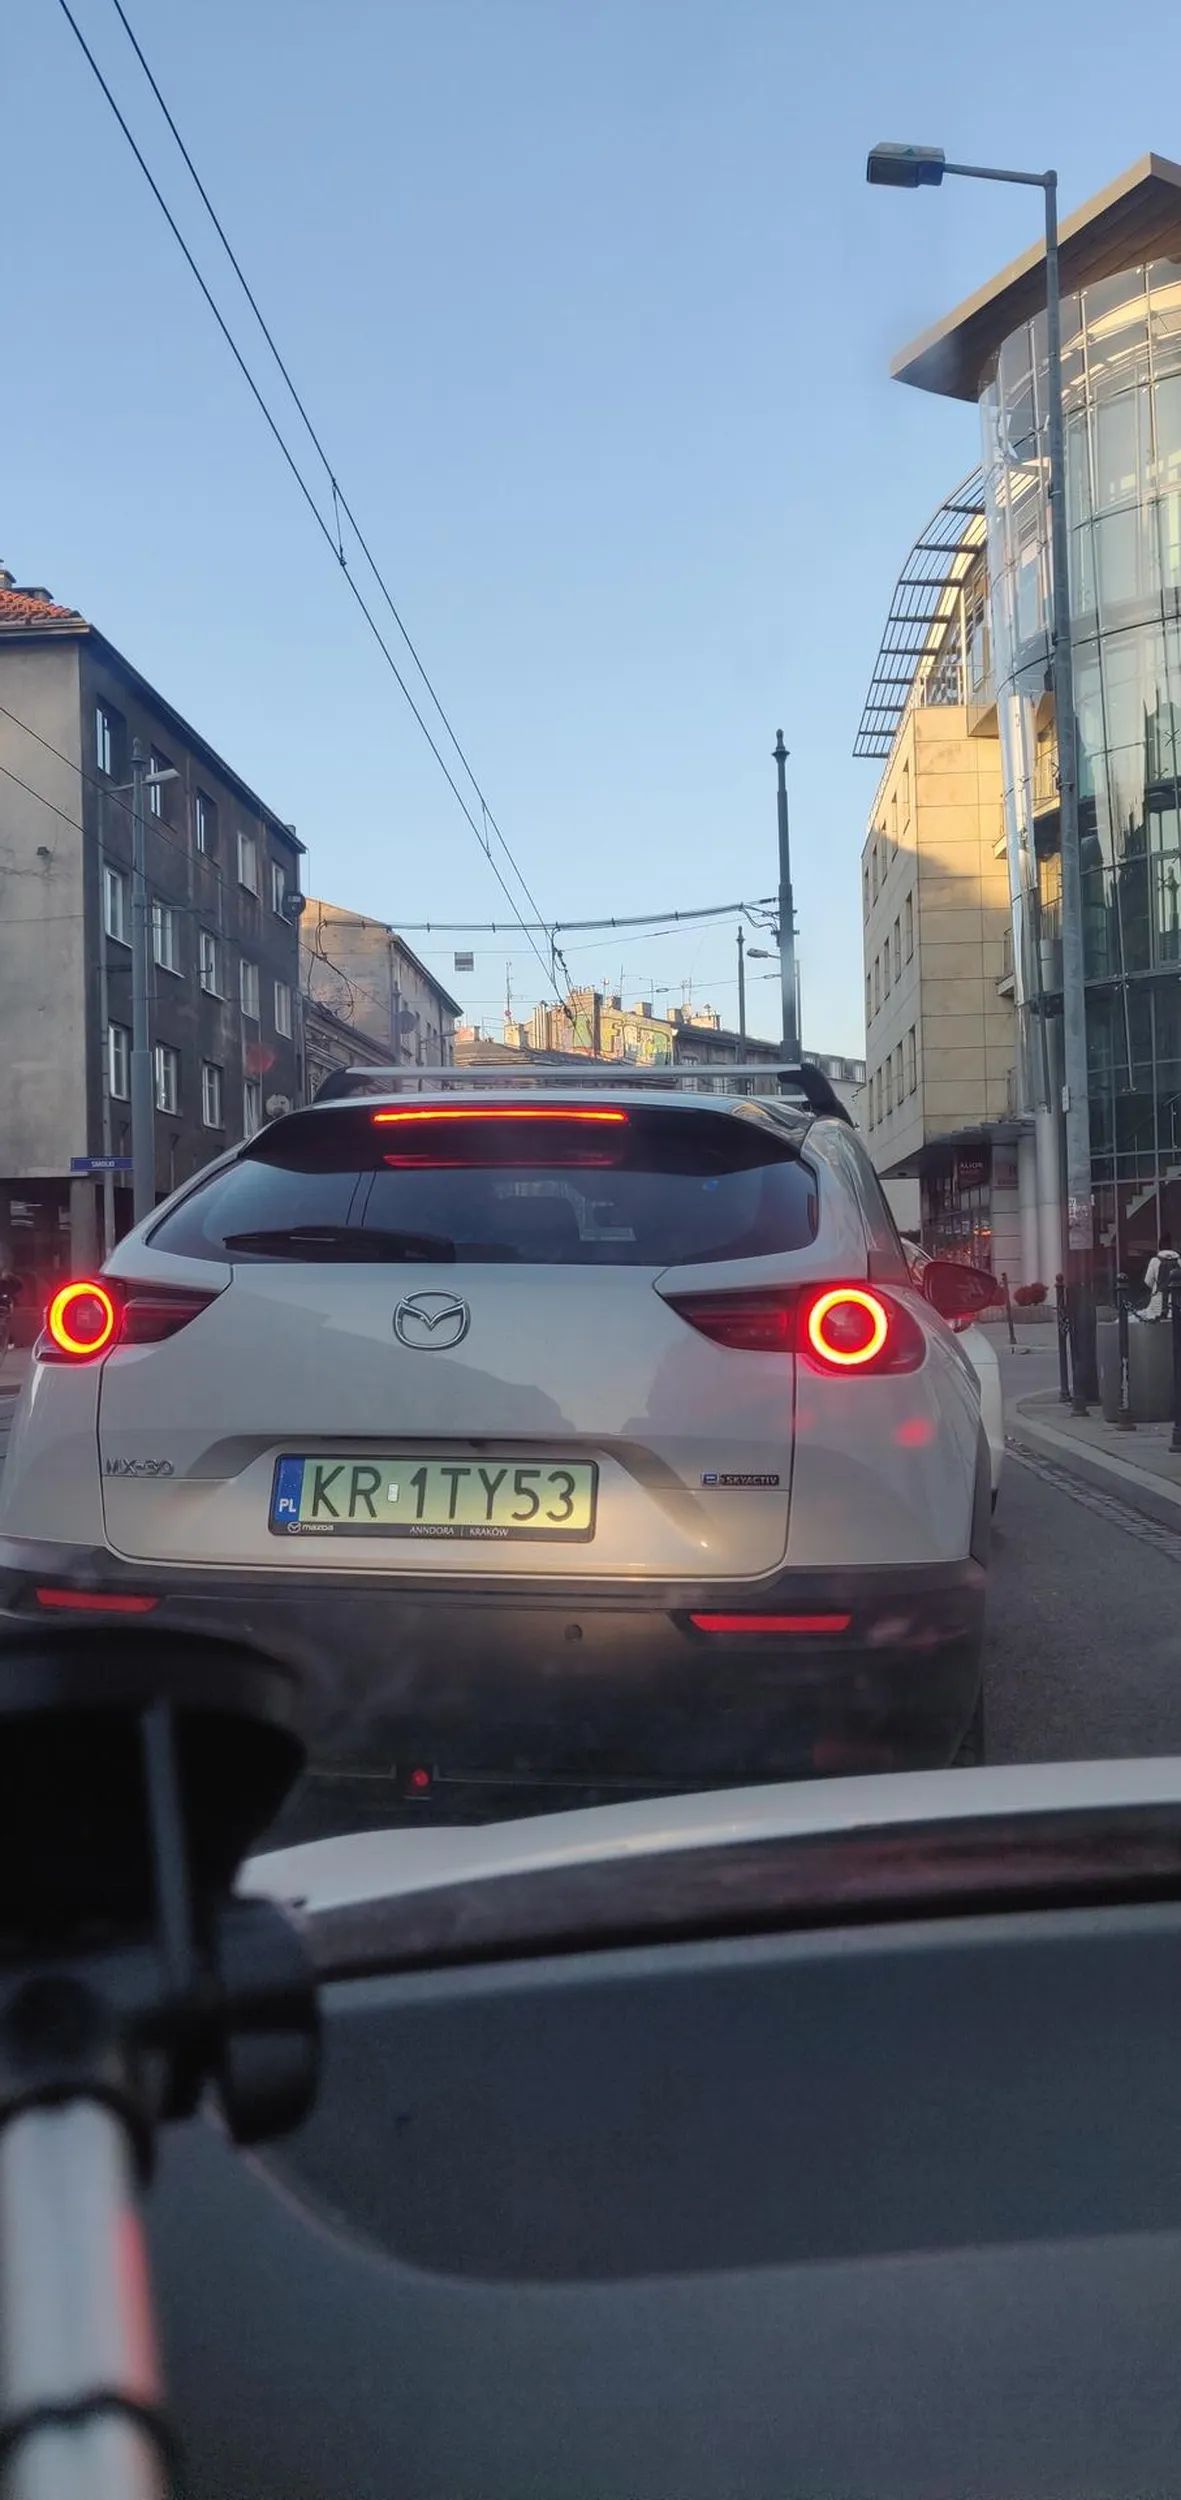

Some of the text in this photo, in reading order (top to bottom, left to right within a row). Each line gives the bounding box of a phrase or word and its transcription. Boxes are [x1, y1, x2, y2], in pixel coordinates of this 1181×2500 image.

[311, 1465, 576, 1522] KR 1TY53
[278, 1498, 297, 1512] PL
[302, 1523, 334, 1531] mazda
[409, 1526, 509, 1537] ANNDORA KRAKÓW
